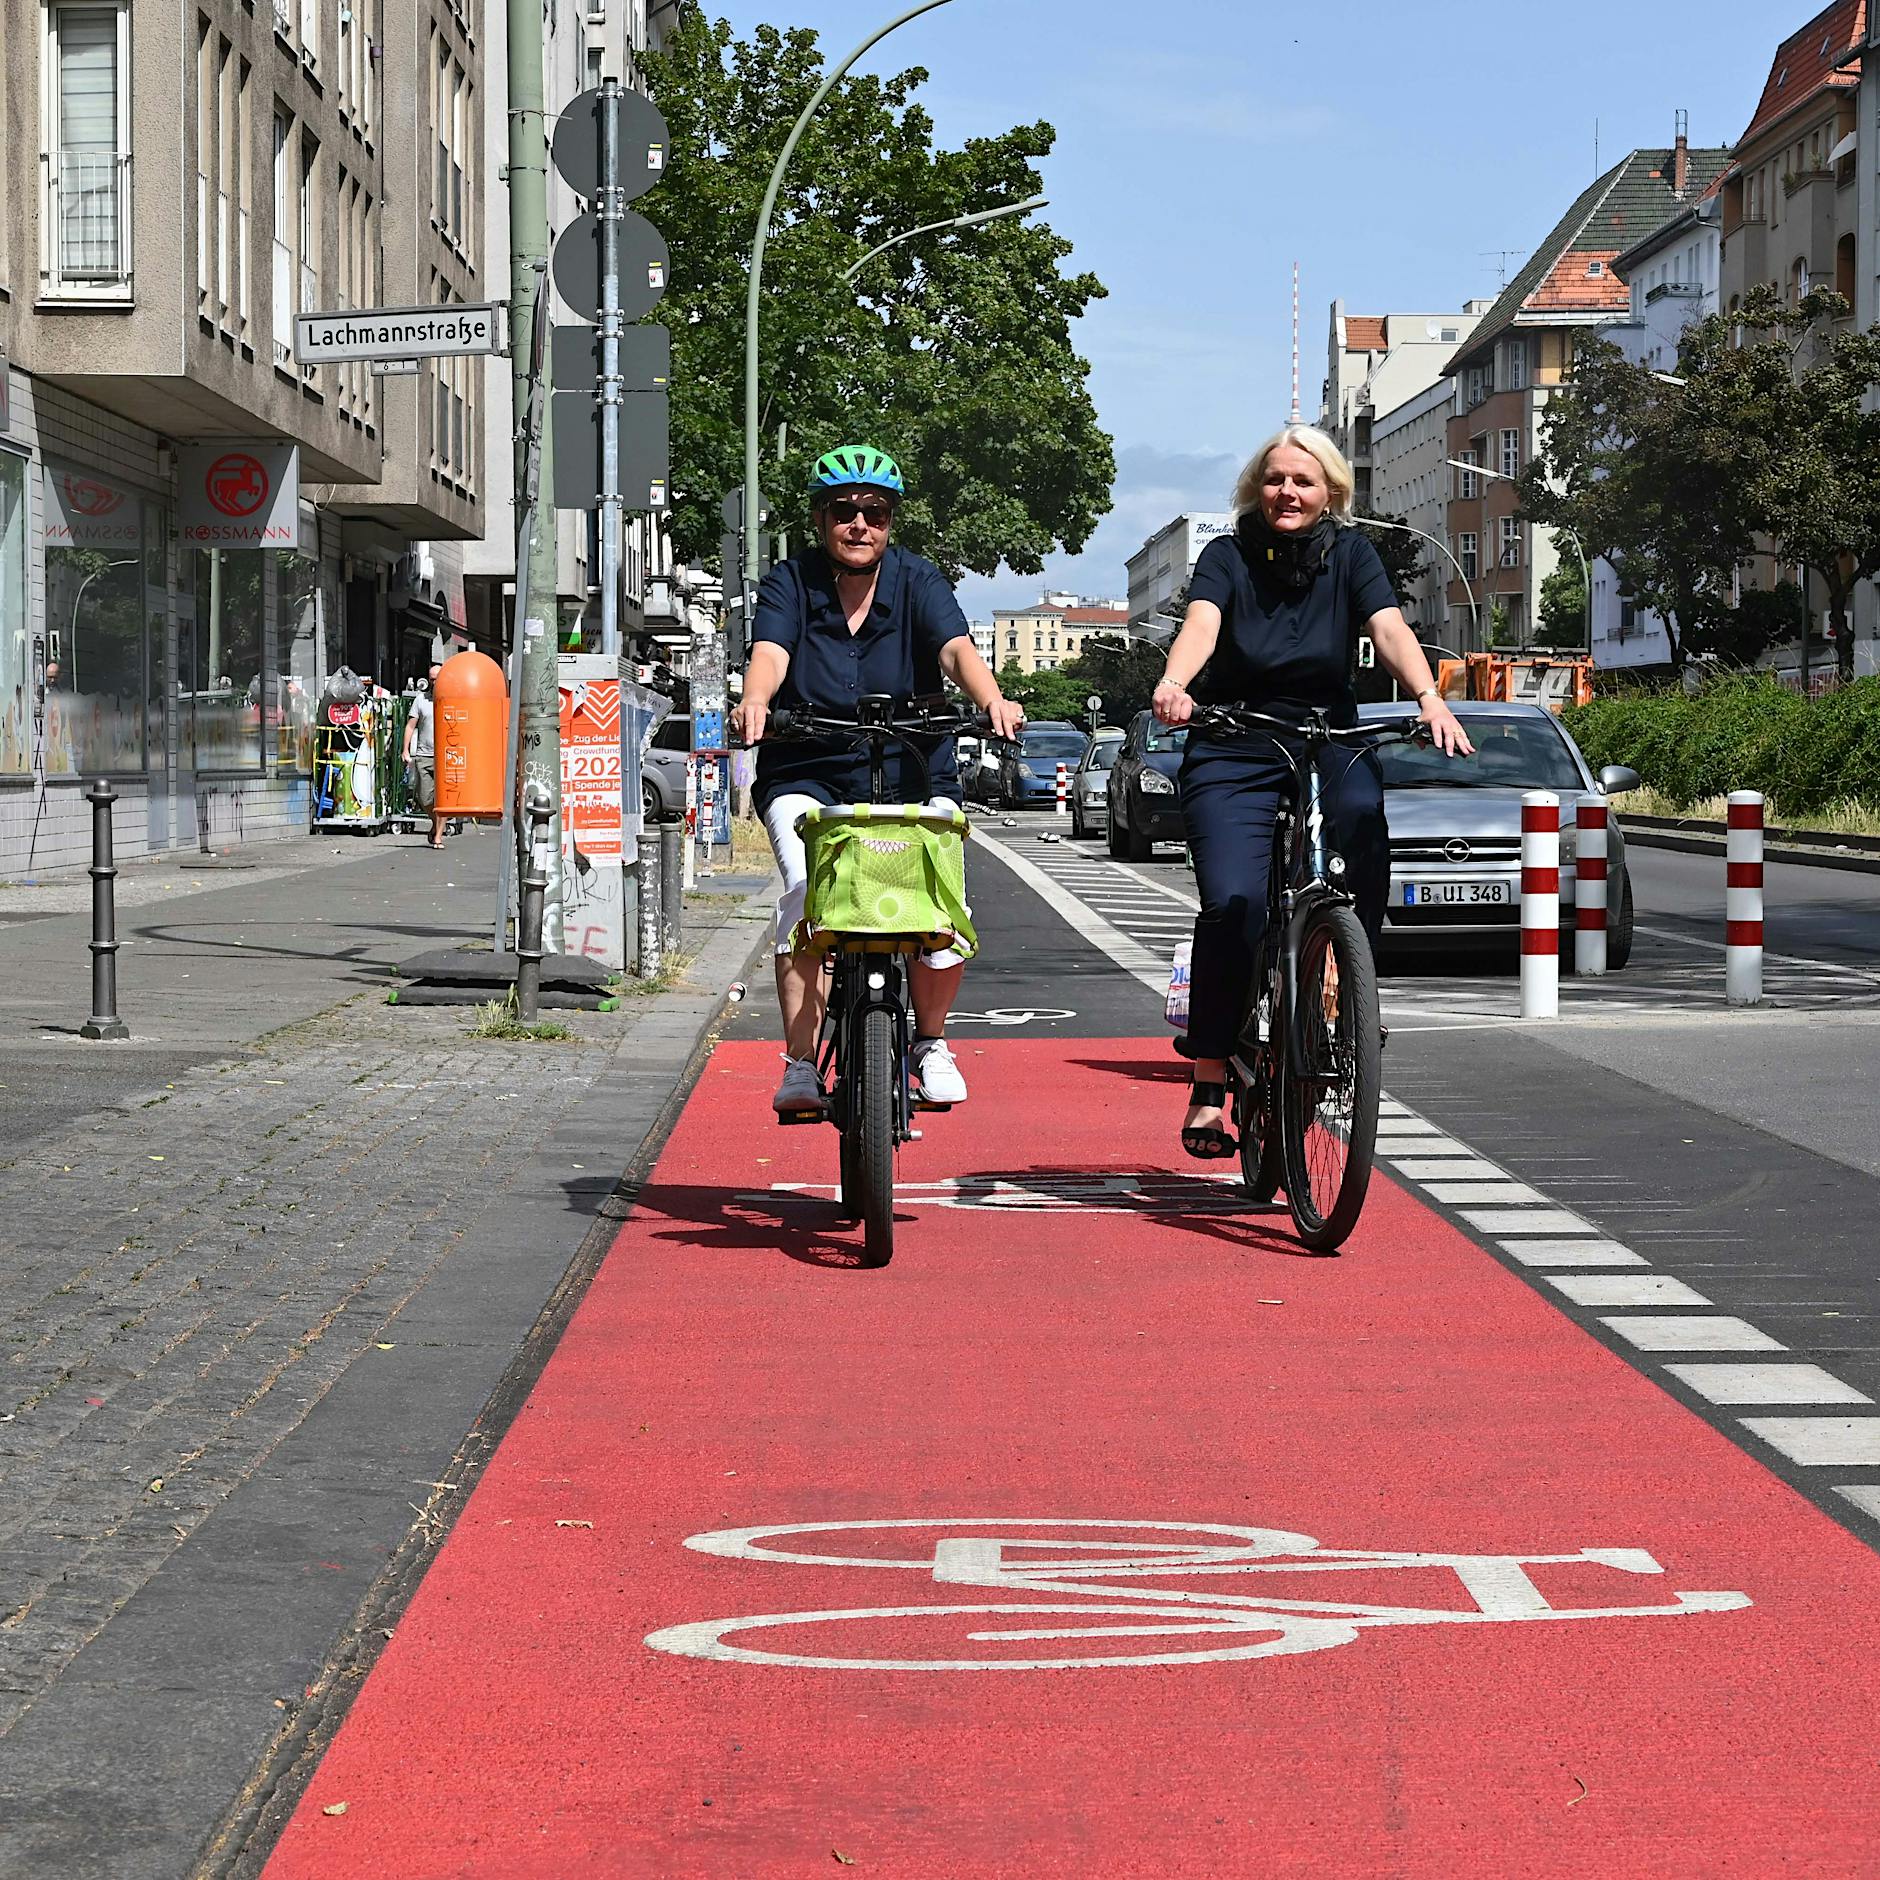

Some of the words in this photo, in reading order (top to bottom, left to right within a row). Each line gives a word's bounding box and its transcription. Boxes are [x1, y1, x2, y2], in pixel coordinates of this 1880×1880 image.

[308, 316, 486, 346] Lachmannstraße
[184, 523, 291, 541] ROSSMANN
[1196, 523, 1233, 534] Blanke
[573, 735, 591, 744] Zug
[592, 734, 607, 742] der
[609, 734, 621, 742] Lie
[573, 746, 621, 755] Crowdfund
[574, 756, 621, 777] 202
[575, 781, 610, 790] Spende
[612, 780, 621, 790] je
[1421, 886, 1431, 902] B
[1444, 886, 1465, 902] UI
[1470, 885, 1502, 902] 348
